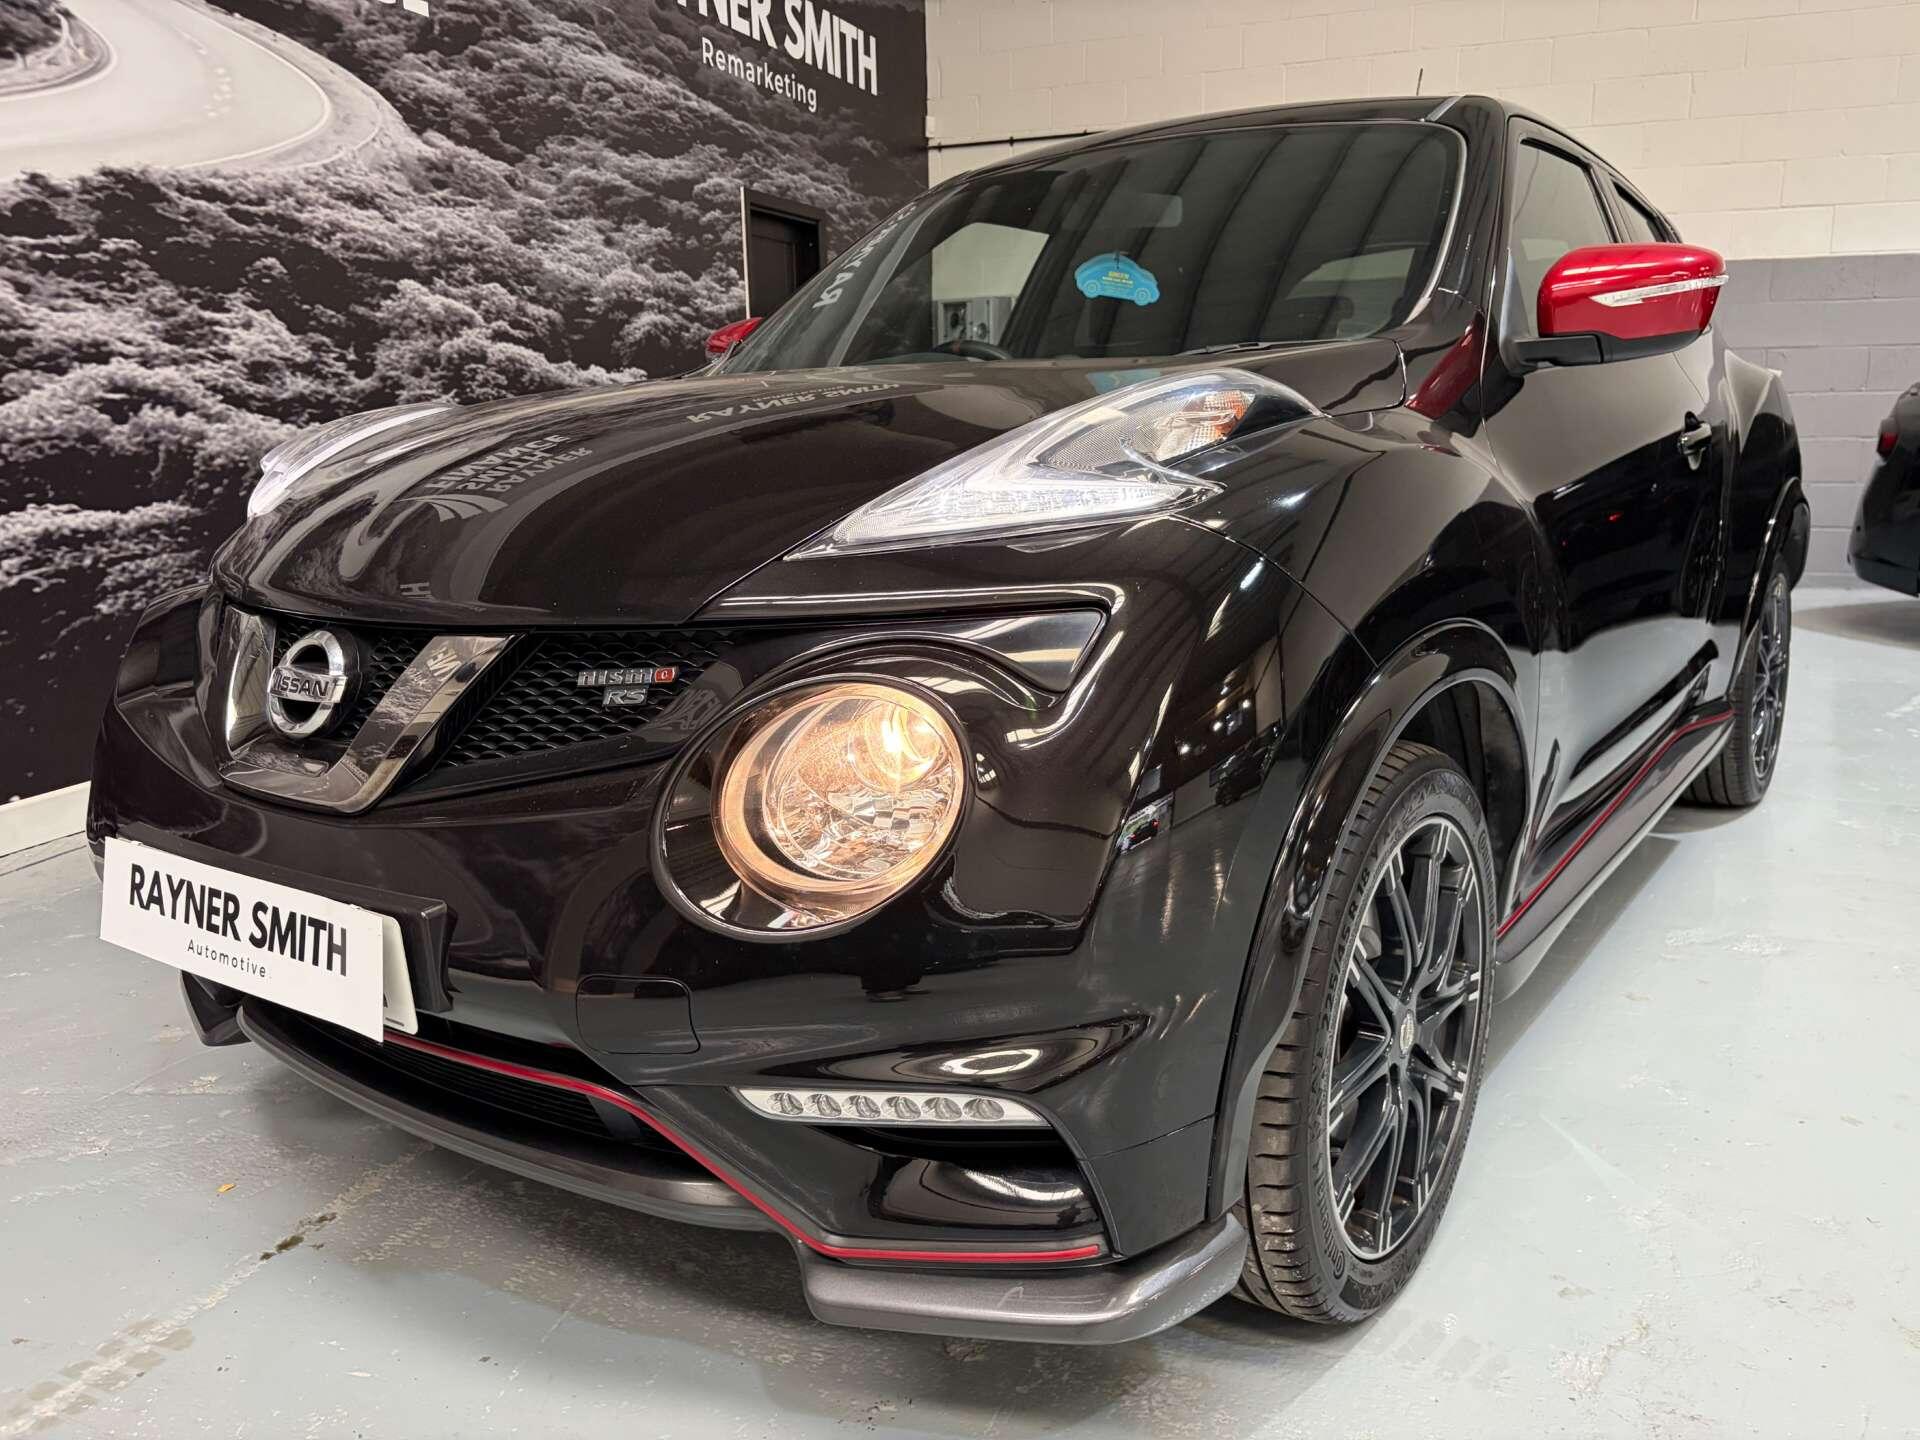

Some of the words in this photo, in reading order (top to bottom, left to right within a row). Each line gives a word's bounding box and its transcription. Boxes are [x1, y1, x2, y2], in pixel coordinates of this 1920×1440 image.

[701, 36, 817, 113] Remarketing
[784, 0, 878, 96] SMITH
[272, 667, 330, 698] NISSAN
[602, 687, 646, 705] RS
[129, 863, 242, 942] RAYNER
[249, 901, 347, 976] SMITH
[187, 938, 267, 978] Automotive
